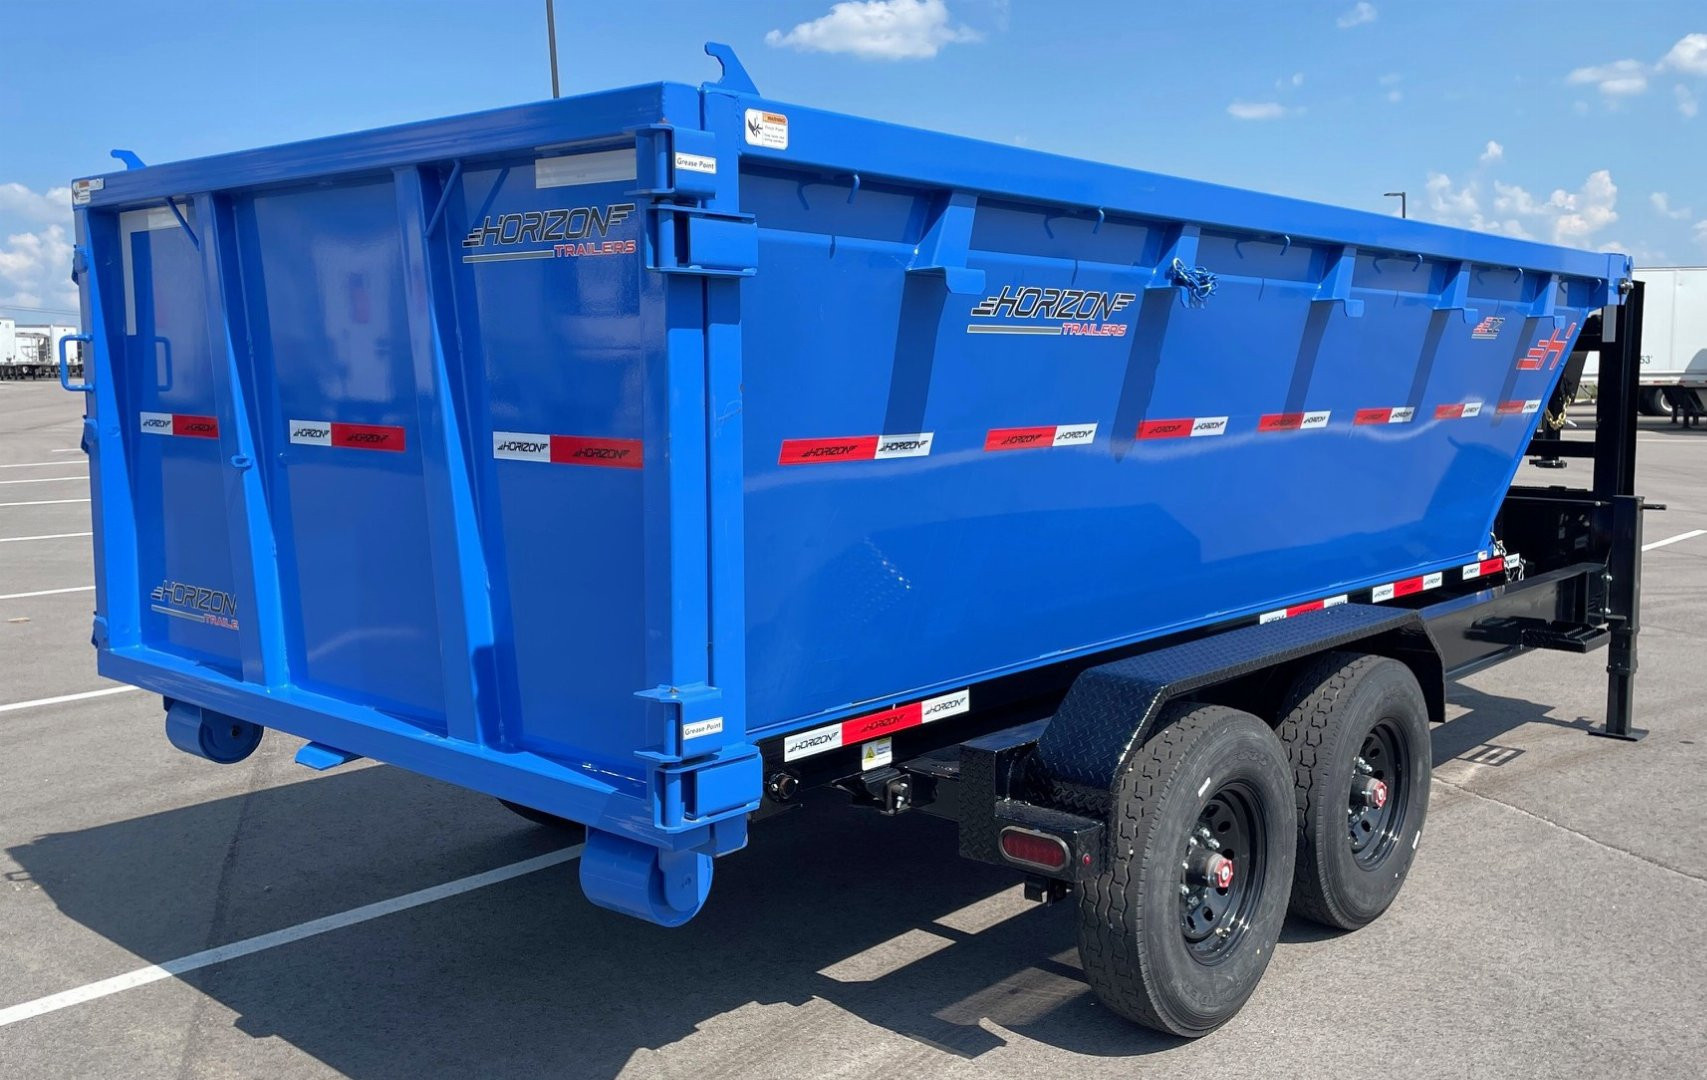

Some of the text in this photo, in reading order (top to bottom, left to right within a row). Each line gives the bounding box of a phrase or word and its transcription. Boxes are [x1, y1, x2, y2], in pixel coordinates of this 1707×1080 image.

[676, 156, 714, 170] Grease Point
[462, 202, 636, 248] HORIZON
[554, 240, 636, 258] TRAILERS
[971, 285, 1136, 321] HORIZON
[1062, 322, 1128, 337] TRAILERS
[293, 428, 330, 438] HORIZON
[497, 440, 631, 460] HORIZON HORIZON
[801, 440, 929, 458] HORIZON HORIZON
[151, 580, 237, 617] HORIZON
[684, 722, 721, 736] Grease Point
[787, 697, 967, 753] HORIZON HORIZON HORIZON
